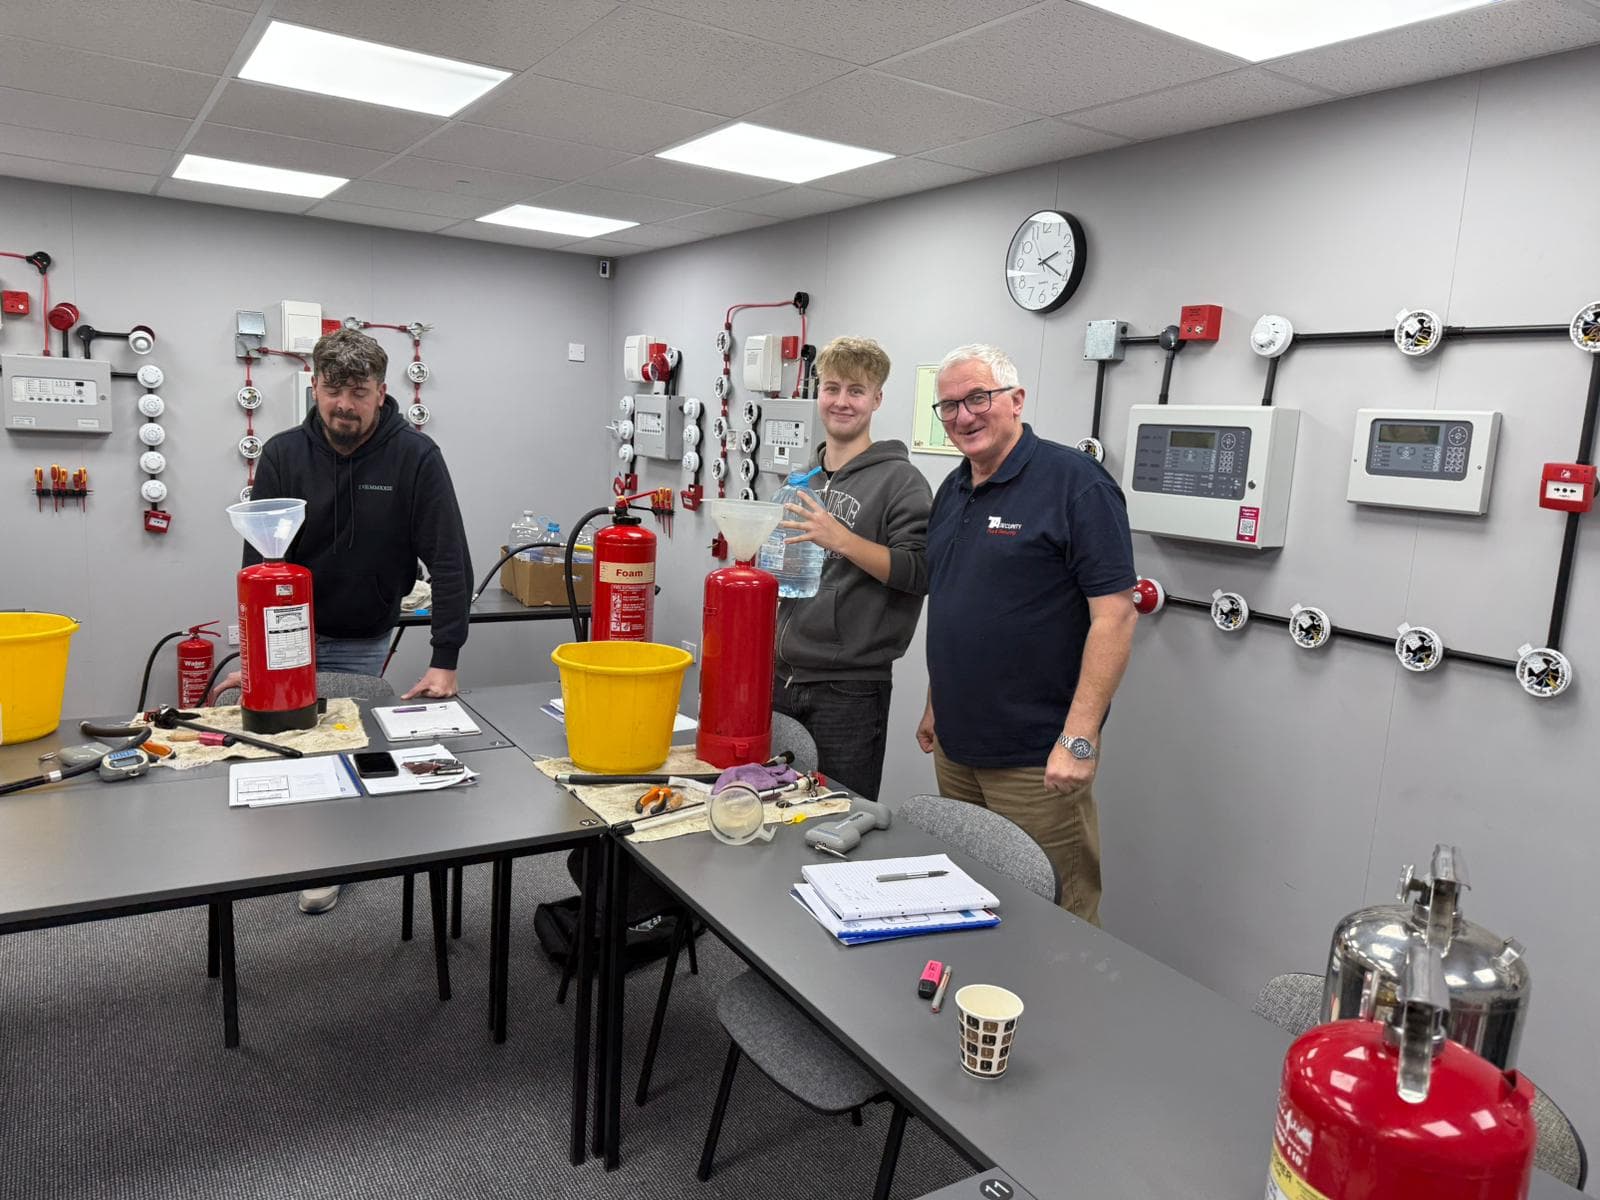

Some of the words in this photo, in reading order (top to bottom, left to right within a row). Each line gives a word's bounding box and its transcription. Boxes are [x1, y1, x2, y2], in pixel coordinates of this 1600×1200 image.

[1031, 225, 1040, 240] 11
[1042, 222, 1052, 234] 12
[1021, 240, 1033, 254] 10
[1063, 233, 1072, 248] 2
[1016, 257, 1025, 271] 9
[1066, 249, 1074, 264] 3
[1018, 274, 1026, 289] 8
[1061, 269, 1069, 282] 4
[1027, 286, 1035, 301] 7
[1038, 289, 1046, 304] 6
[1051, 282, 1059, 297] 5
[615, 568, 644, 578] Foam
[985, 1180, 1010, 1198] 11
